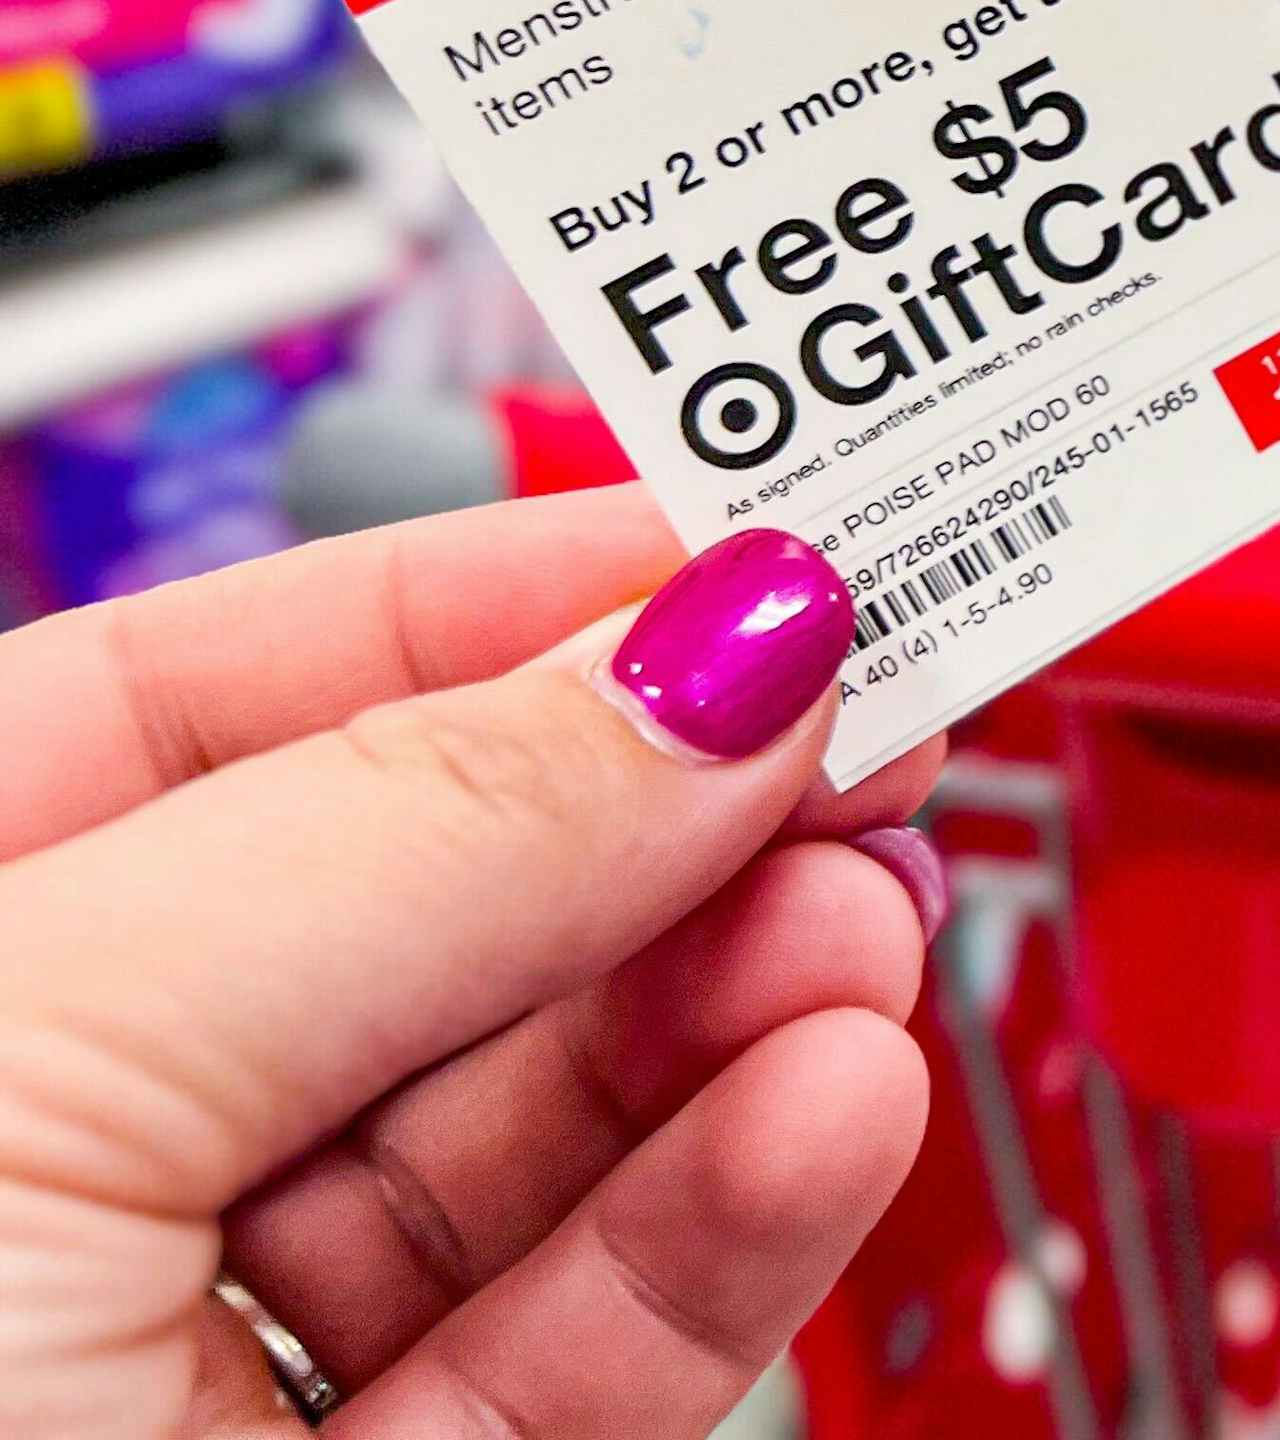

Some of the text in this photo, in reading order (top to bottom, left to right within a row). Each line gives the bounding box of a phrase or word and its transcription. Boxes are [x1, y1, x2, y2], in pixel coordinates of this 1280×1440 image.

[473, 53, 615, 137] items
[547, 178, 656, 254] Buy
[663, 149, 708, 197] 2
[713, 119, 767, 170] or
[778, 49, 936, 138] more,
[597, 53, 1089, 377] Free $5
[726, 271, 1165, 520] As signed. Quantities limited; no rain checks.
[840, 472, 936, 539] POISE
[933, 437, 998, 487] PAD
[998, 395, 1072, 448] MOD
[1074, 373, 1111, 407] 60
[844, 380, 1200, 601] 59/726624290/245-01-1565
[864, 653, 901, 687] 40
[901, 629, 938, 665] (4)
[942, 561, 1054, 638] 1-5-4.90
